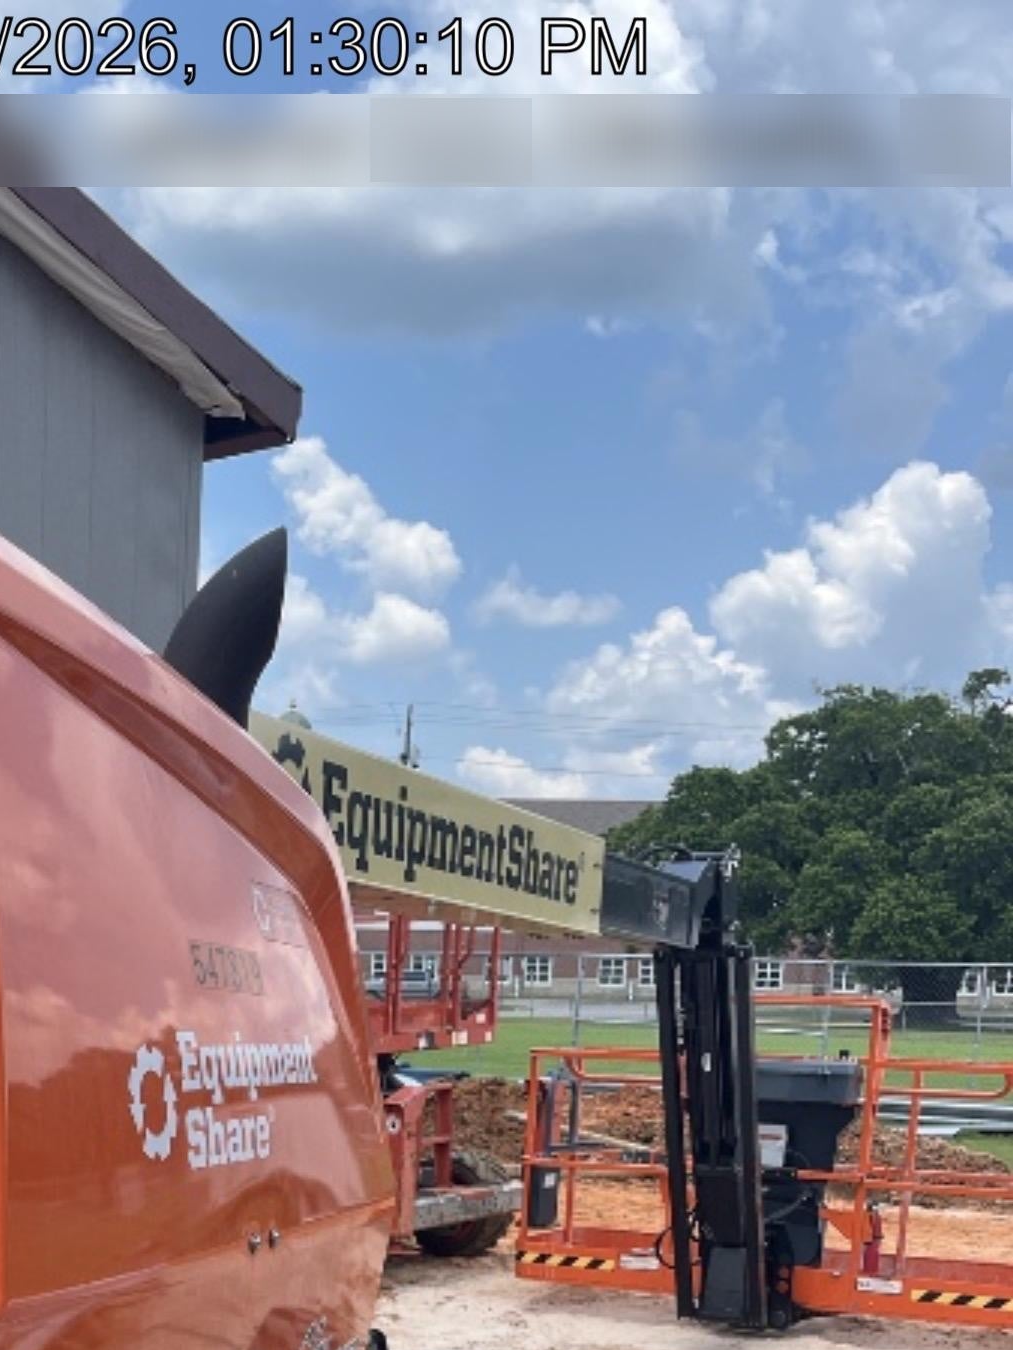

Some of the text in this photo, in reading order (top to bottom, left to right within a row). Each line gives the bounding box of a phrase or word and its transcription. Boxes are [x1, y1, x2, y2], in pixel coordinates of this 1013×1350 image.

[321, 760, 580, 904] EquipmentShare
[176, 1030, 314, 1101] Equipment
[186, 1105, 271, 1169] Share
